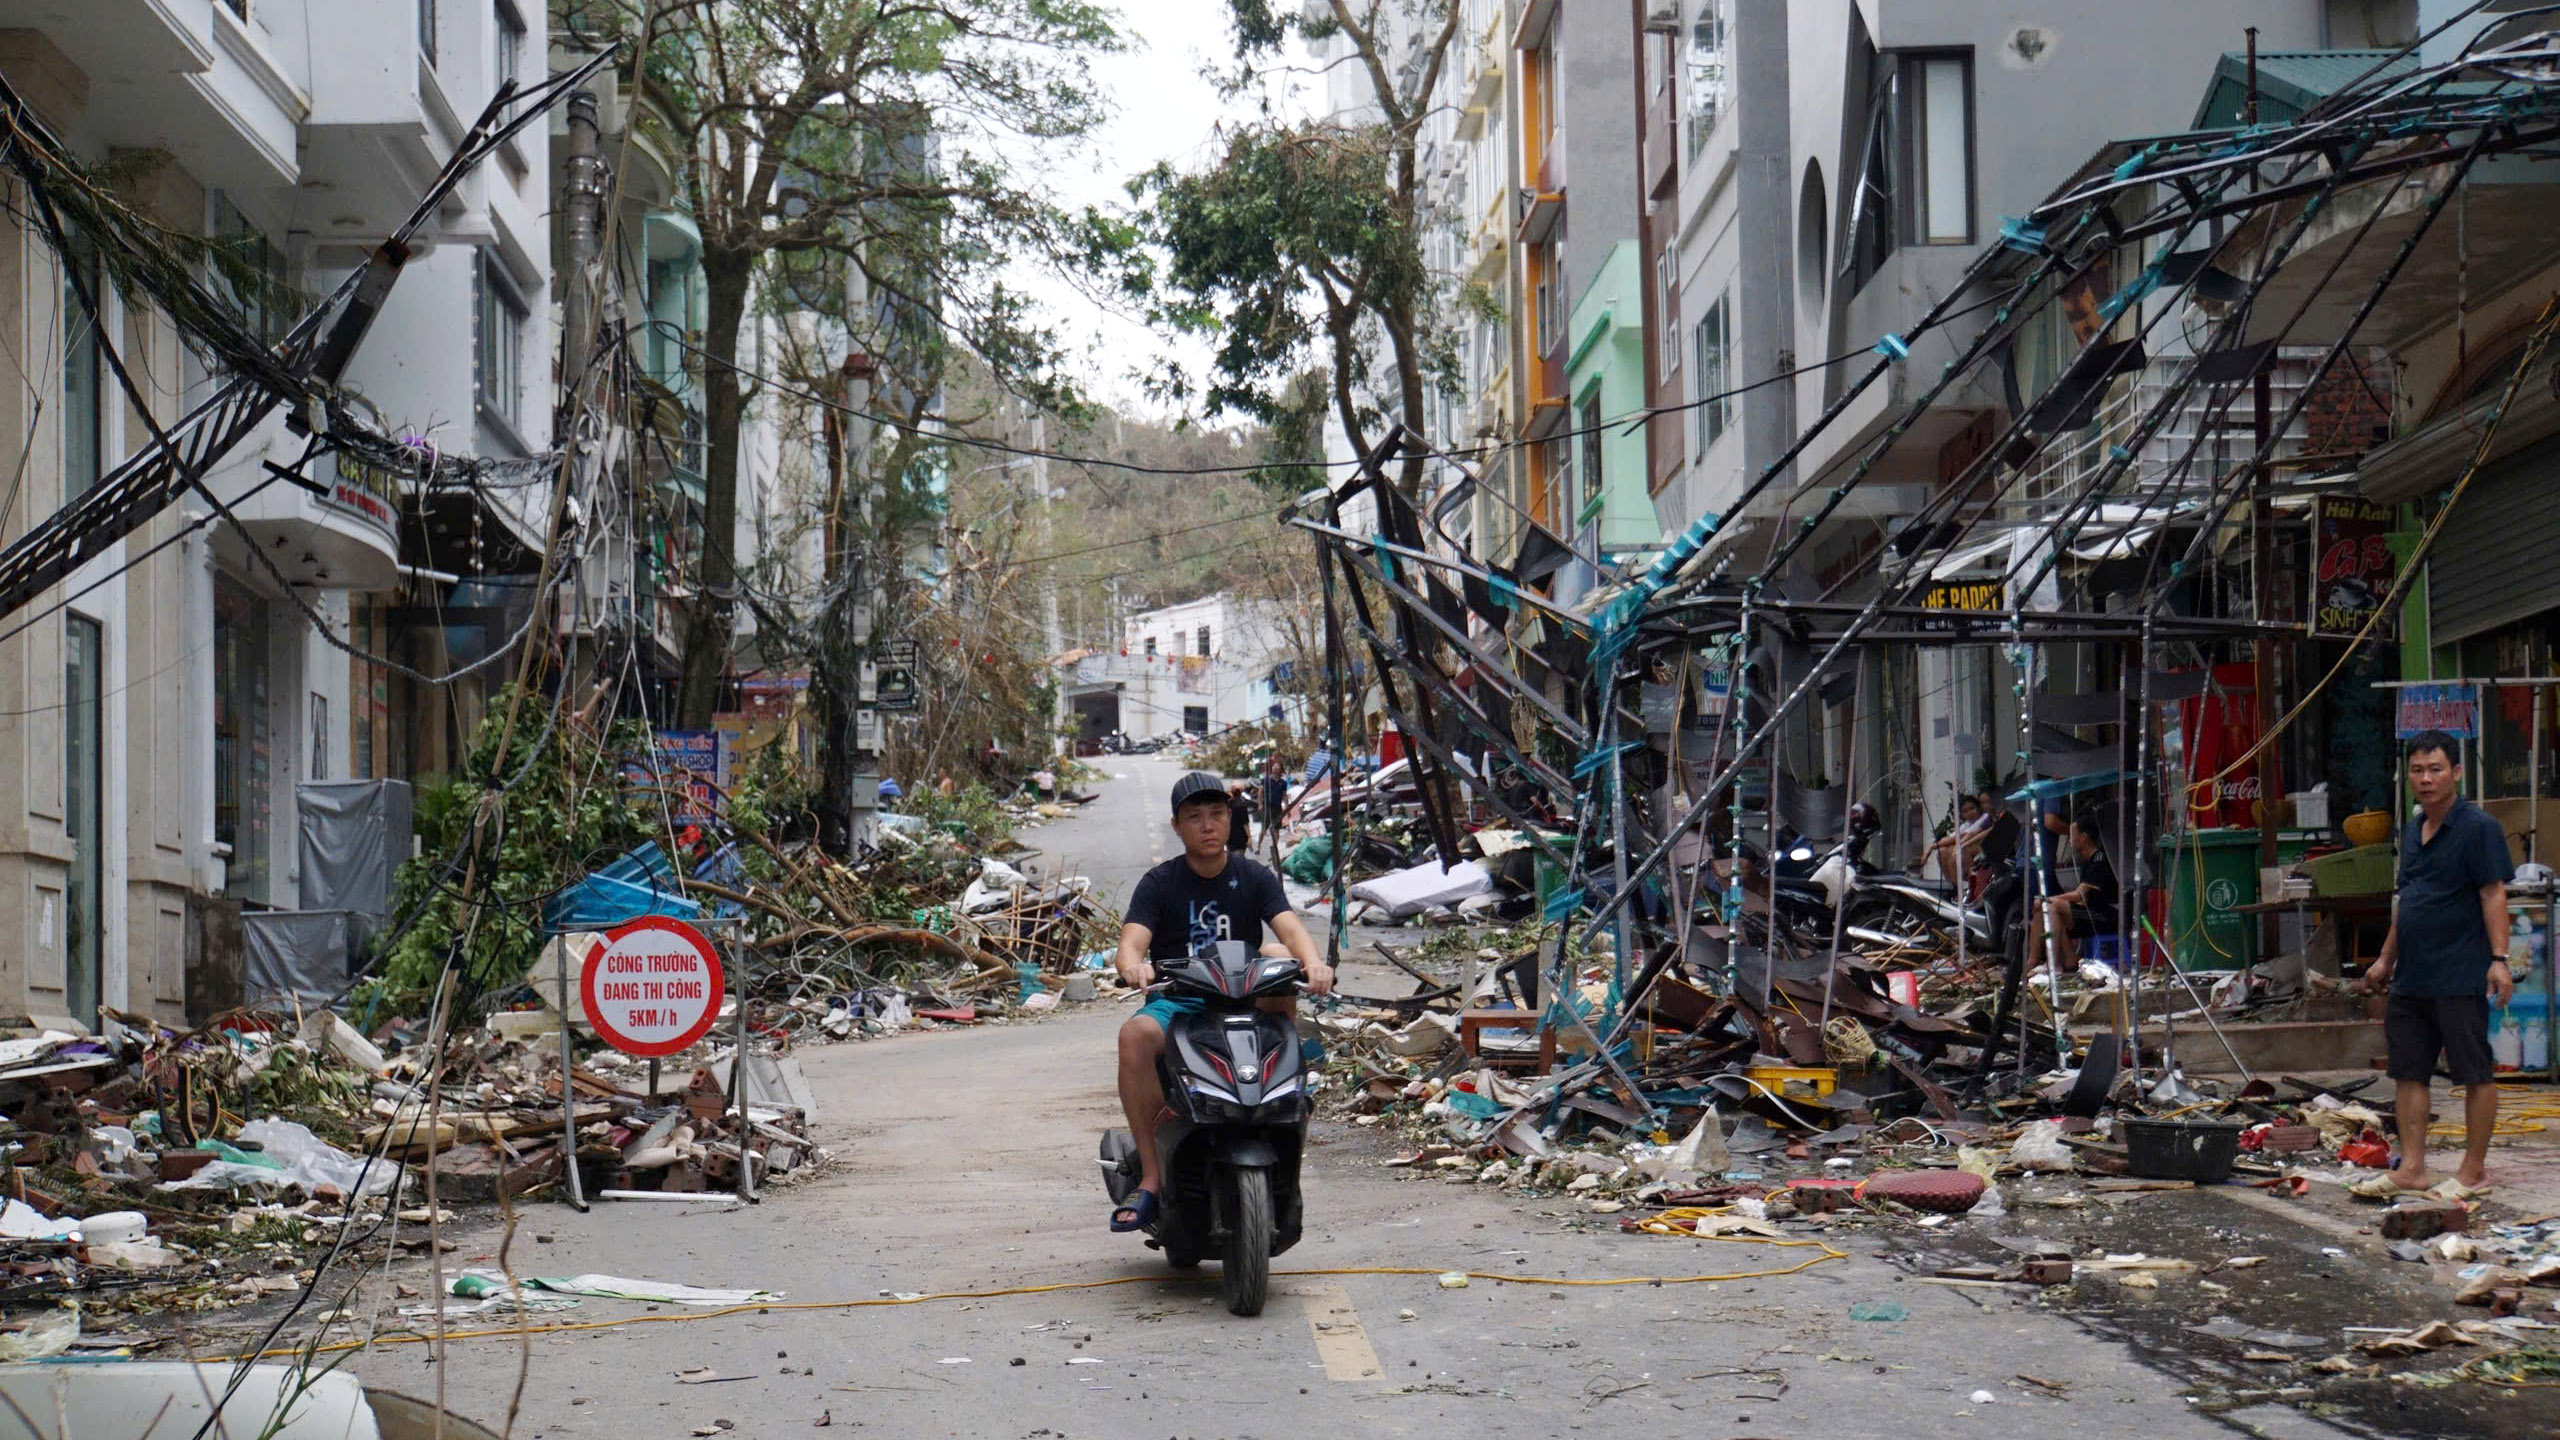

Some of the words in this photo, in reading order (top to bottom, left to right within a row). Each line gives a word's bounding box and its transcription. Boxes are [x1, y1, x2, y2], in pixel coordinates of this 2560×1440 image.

[607, 952, 643, 973] CÔNG
[647, 950, 698, 973] TRƯỜNG
[603, 982, 639, 1000] ĐANG
[643, 982, 663, 1000] THI
[666, 977, 702, 1000] CÔNG
